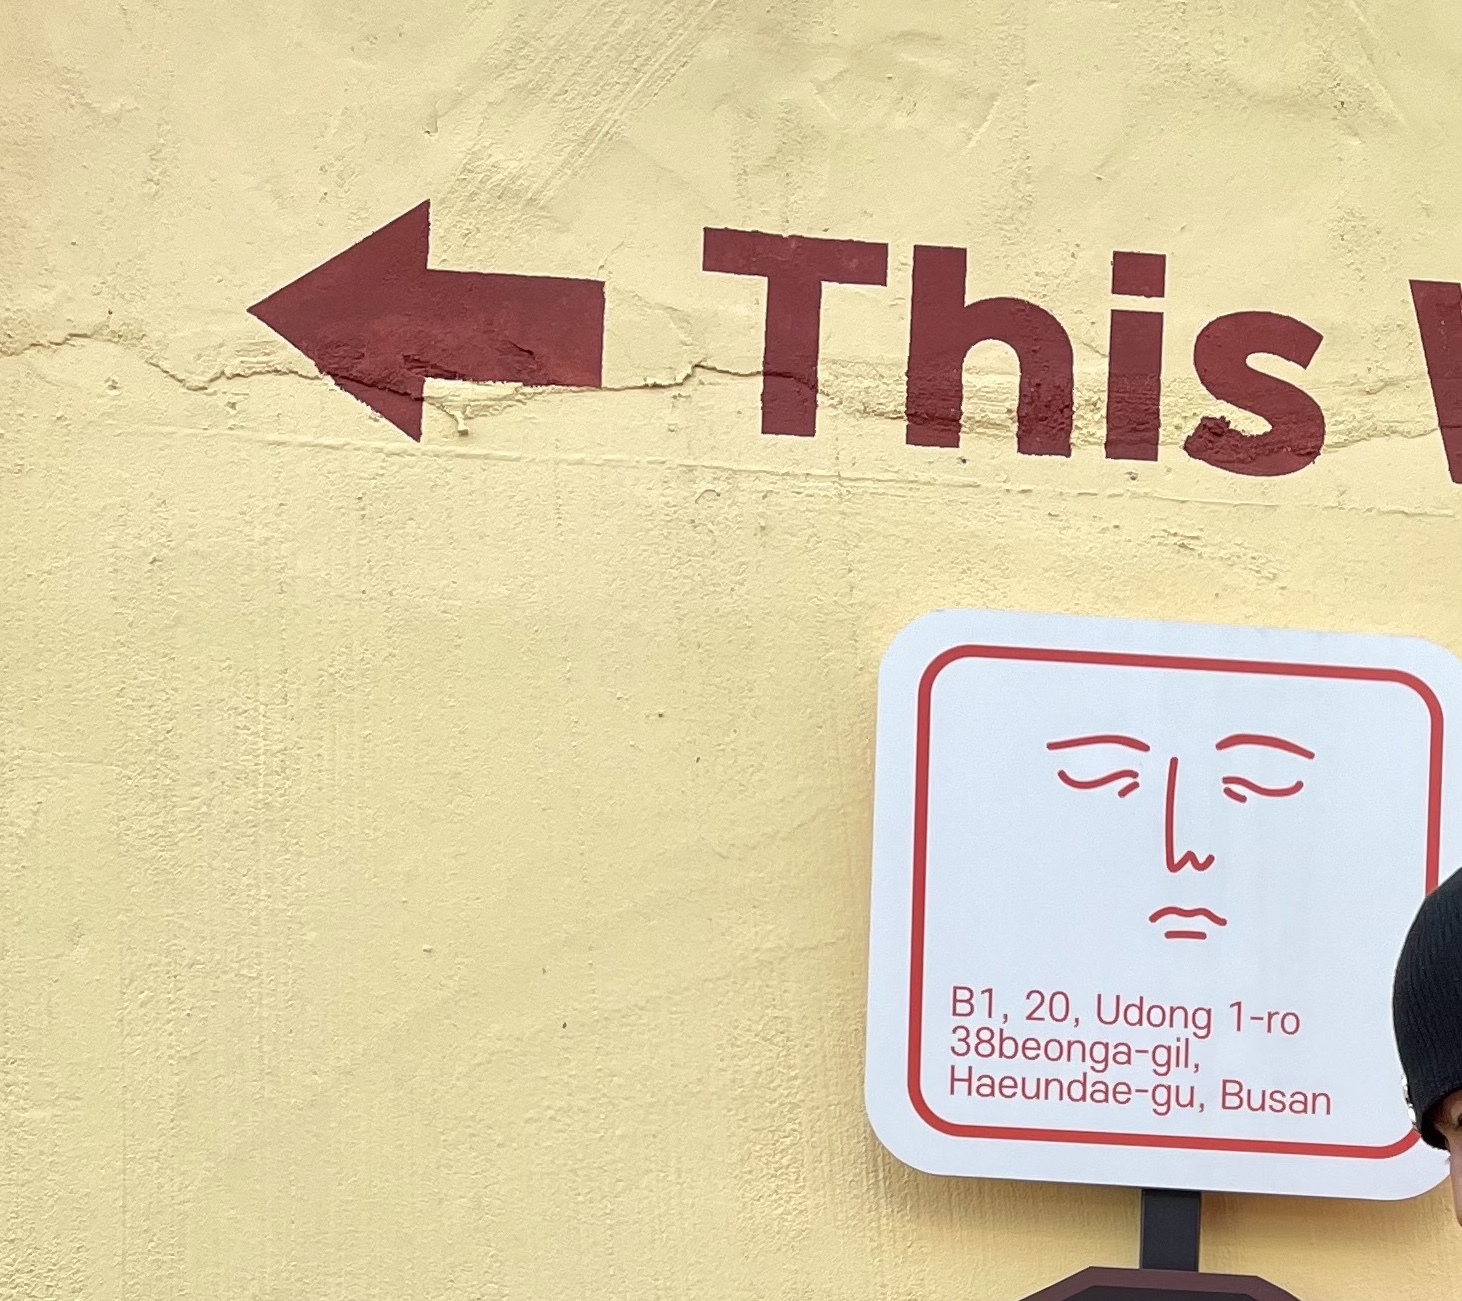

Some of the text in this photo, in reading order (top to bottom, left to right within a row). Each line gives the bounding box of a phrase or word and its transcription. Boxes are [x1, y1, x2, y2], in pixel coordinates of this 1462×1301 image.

[703, 227, 1325, 477] This
[952, 986, 1301, 1038] B1, 20, Udong 1-ro
[950, 1026, 1201, 1076] 38beonga-gil,
[949, 1066, 1332, 1116] Haeundae-gu, Busan
